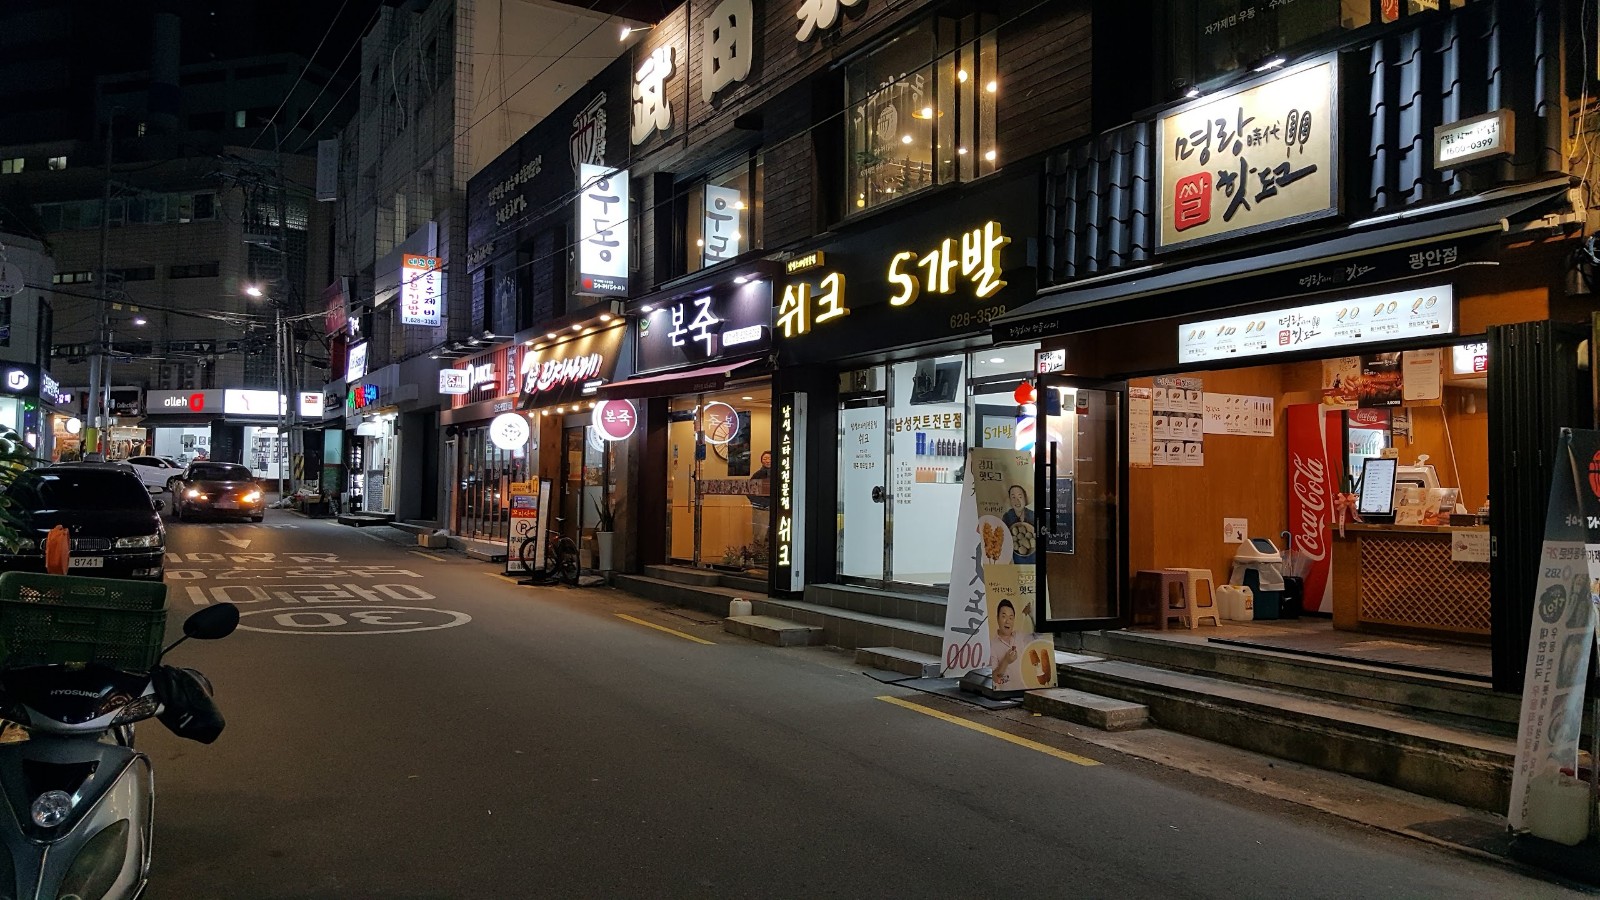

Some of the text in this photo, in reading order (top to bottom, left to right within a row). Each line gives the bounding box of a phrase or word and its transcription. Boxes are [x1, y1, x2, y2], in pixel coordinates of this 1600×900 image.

[1205, 14, 1236, 35] 자가제면
[1238, 7, 1256, 22] 우동
[1175, 107, 1256, 165] 명랑
[1178, 157, 1318, 222] 쌀 핫도그
[588, 173, 621, 263] 우동
[887, 220, 1012, 307] S가발
[1407, 246, 1458, 269] 광안점
[777, 272, 850, 338] 쉬크
[667, 296, 720, 357] 본죽
[1277, 314, 1303, 327] 명랑
[1293, 327, 1322, 343] 핫도그
[164, 397, 188, 408] olleh
[604, 409, 636, 426] 본죽
[858, 432, 870, 444] 쉬크
[984, 423, 1013, 441] S가발
[979, 460, 994, 470] 감자
[979, 472, 1002, 482] 핫도그
[1294, 451, 1326, 561] Coca-Cola
[778, 516, 792, 566] 쉬크
[73, 556, 100, 568] 8741
[185, 583, 438, 606] 어린이
[273, 610, 424, 629] 30
[50, 689, 99, 699] HYOSUNG
